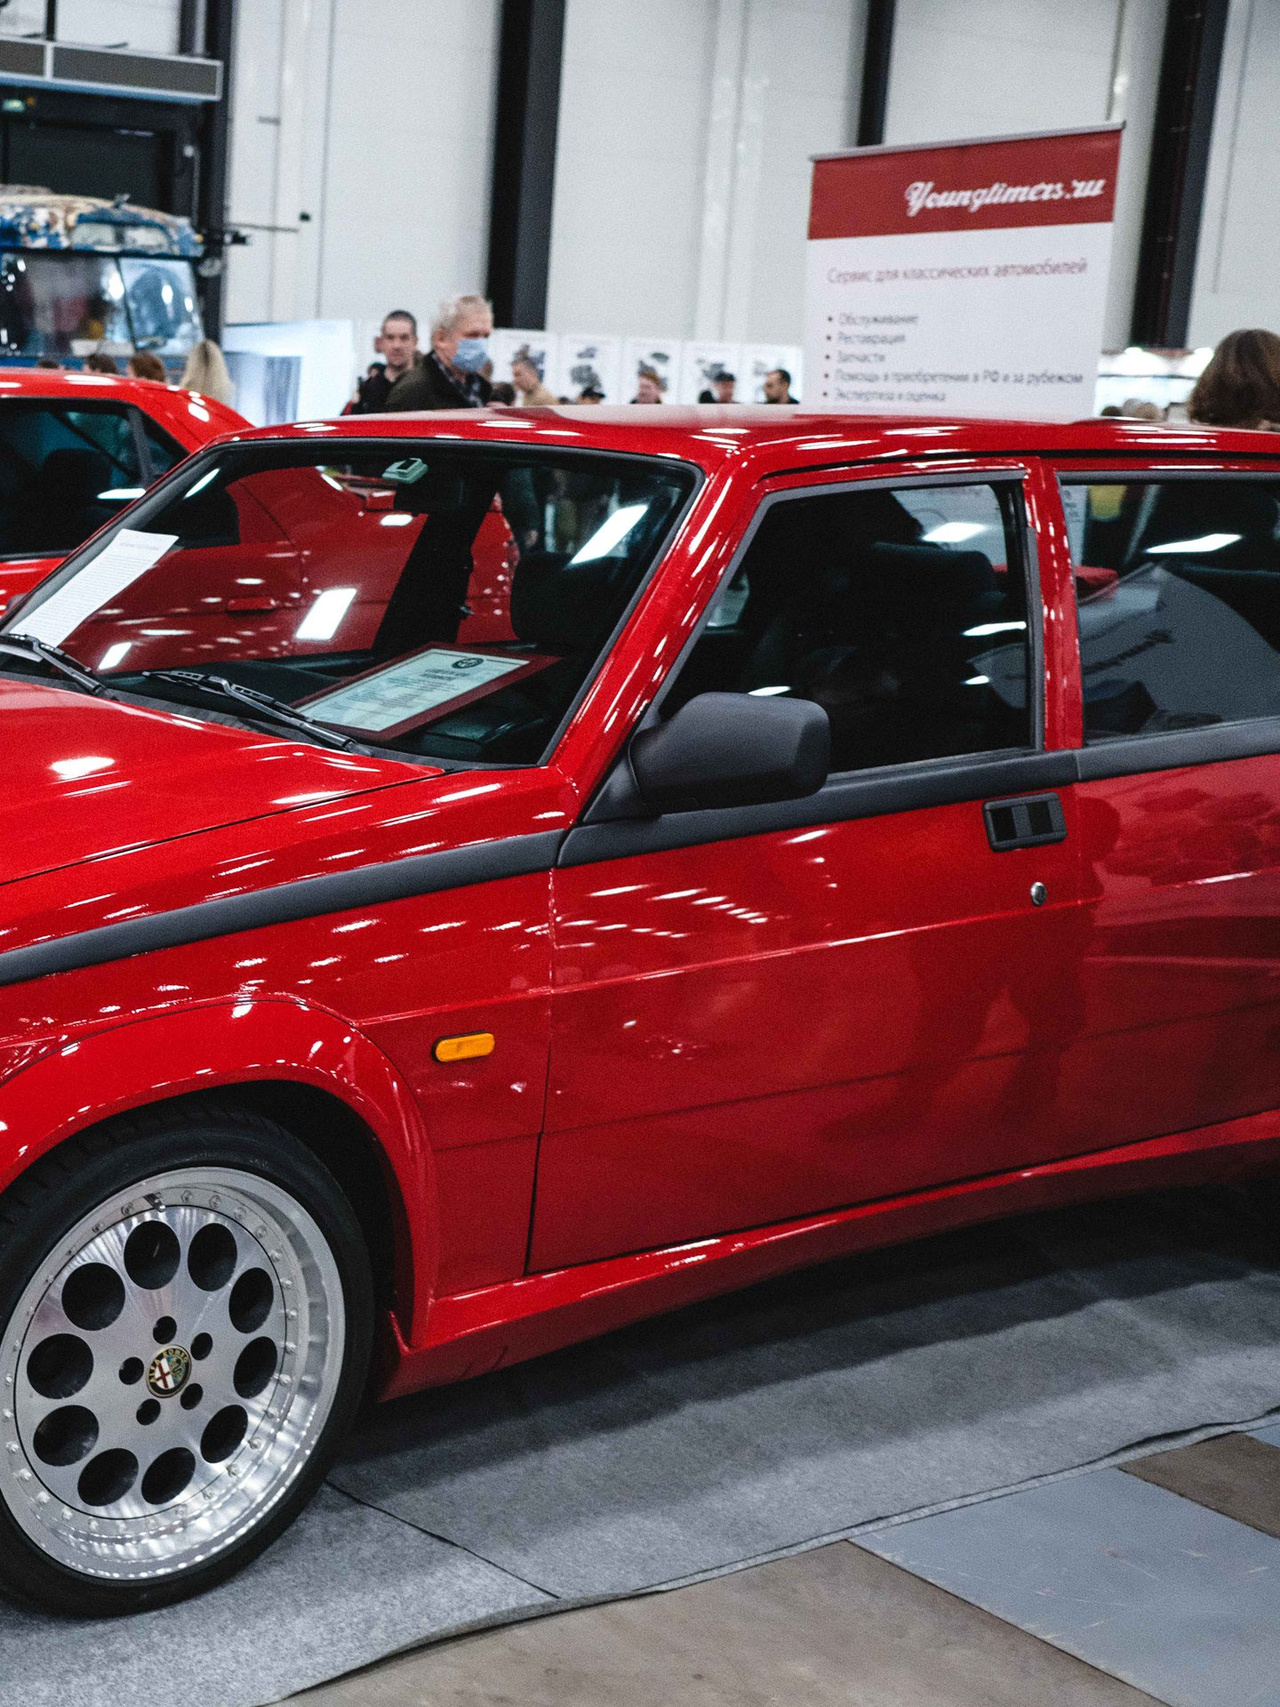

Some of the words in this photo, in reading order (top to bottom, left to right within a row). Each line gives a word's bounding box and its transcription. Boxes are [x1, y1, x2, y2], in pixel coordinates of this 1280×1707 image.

[904, 178, 1107, 218] Youngtimers.ru
[827, 266, 872, 284] Сервис
[875, 268, 900, 284] для
[903, 266, 989, 280] классических
[993, 256, 1088, 278] автомобилей
[838, 311, 918, 328] Обслуживание
[983, 369, 1000, 383] РФ
[1026, 370, 1083, 387] рубежом
